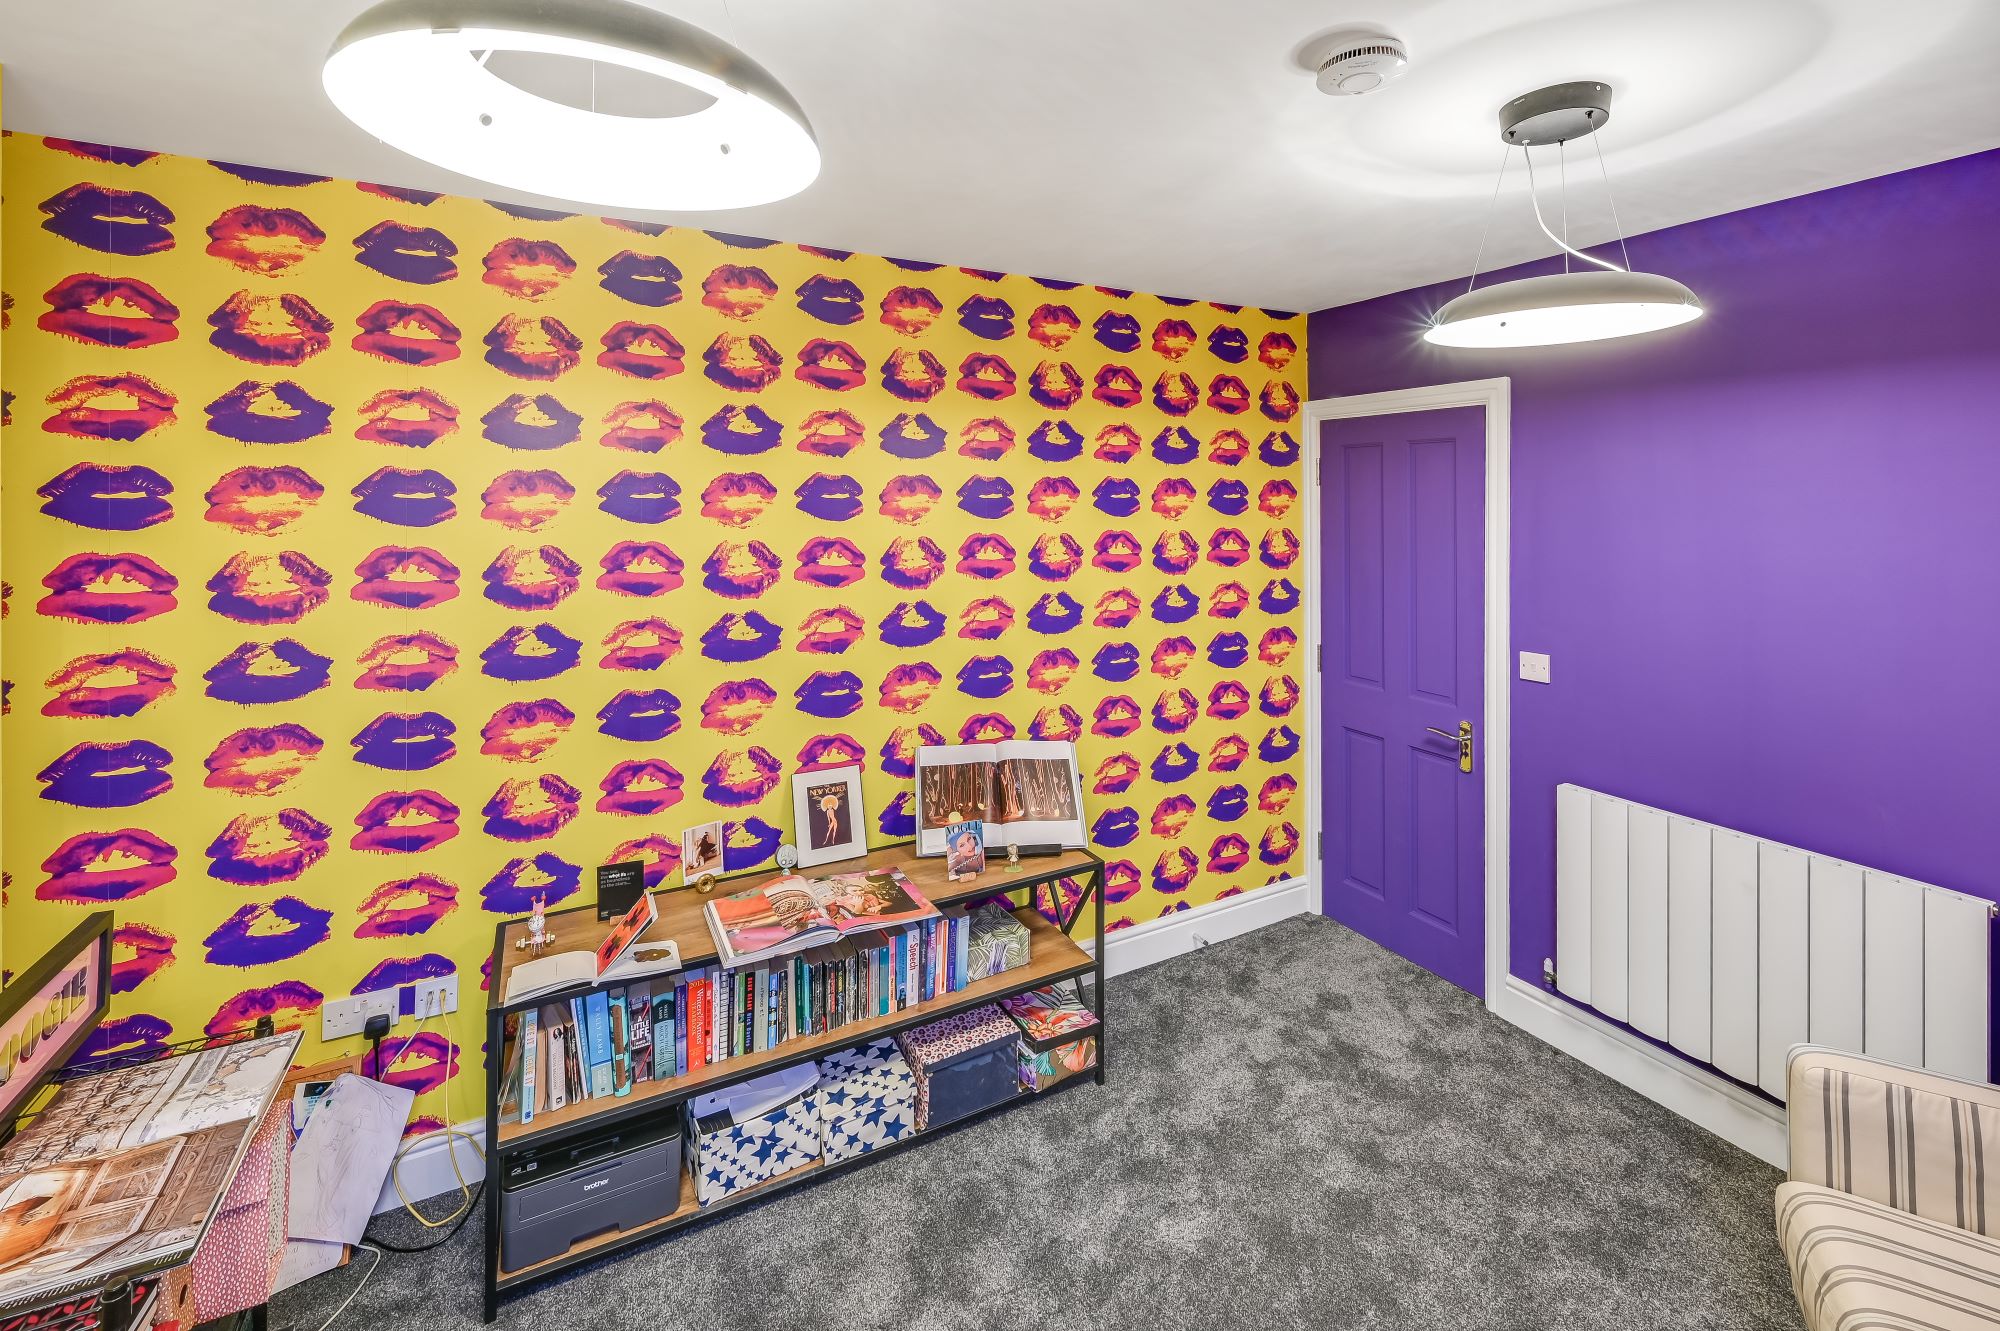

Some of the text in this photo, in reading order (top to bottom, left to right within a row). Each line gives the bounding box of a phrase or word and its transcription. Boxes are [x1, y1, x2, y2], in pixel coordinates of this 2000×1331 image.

[809, 789, 824, 797] NEW
[824, 785, 847, 795] YORKER
[946, 820, 983, 835] VOGUE
[949, 926, 957, 961] CHOCOLAT
[908, 942, 919, 971] Speech
[688, 979, 705, 990] 2013
[631, 1019, 650, 1031] LITTLE
[638, 1015, 643, 1023] A
[631, 1027, 650, 1041] LIFE
[584, 1178, 610, 1191] brother
